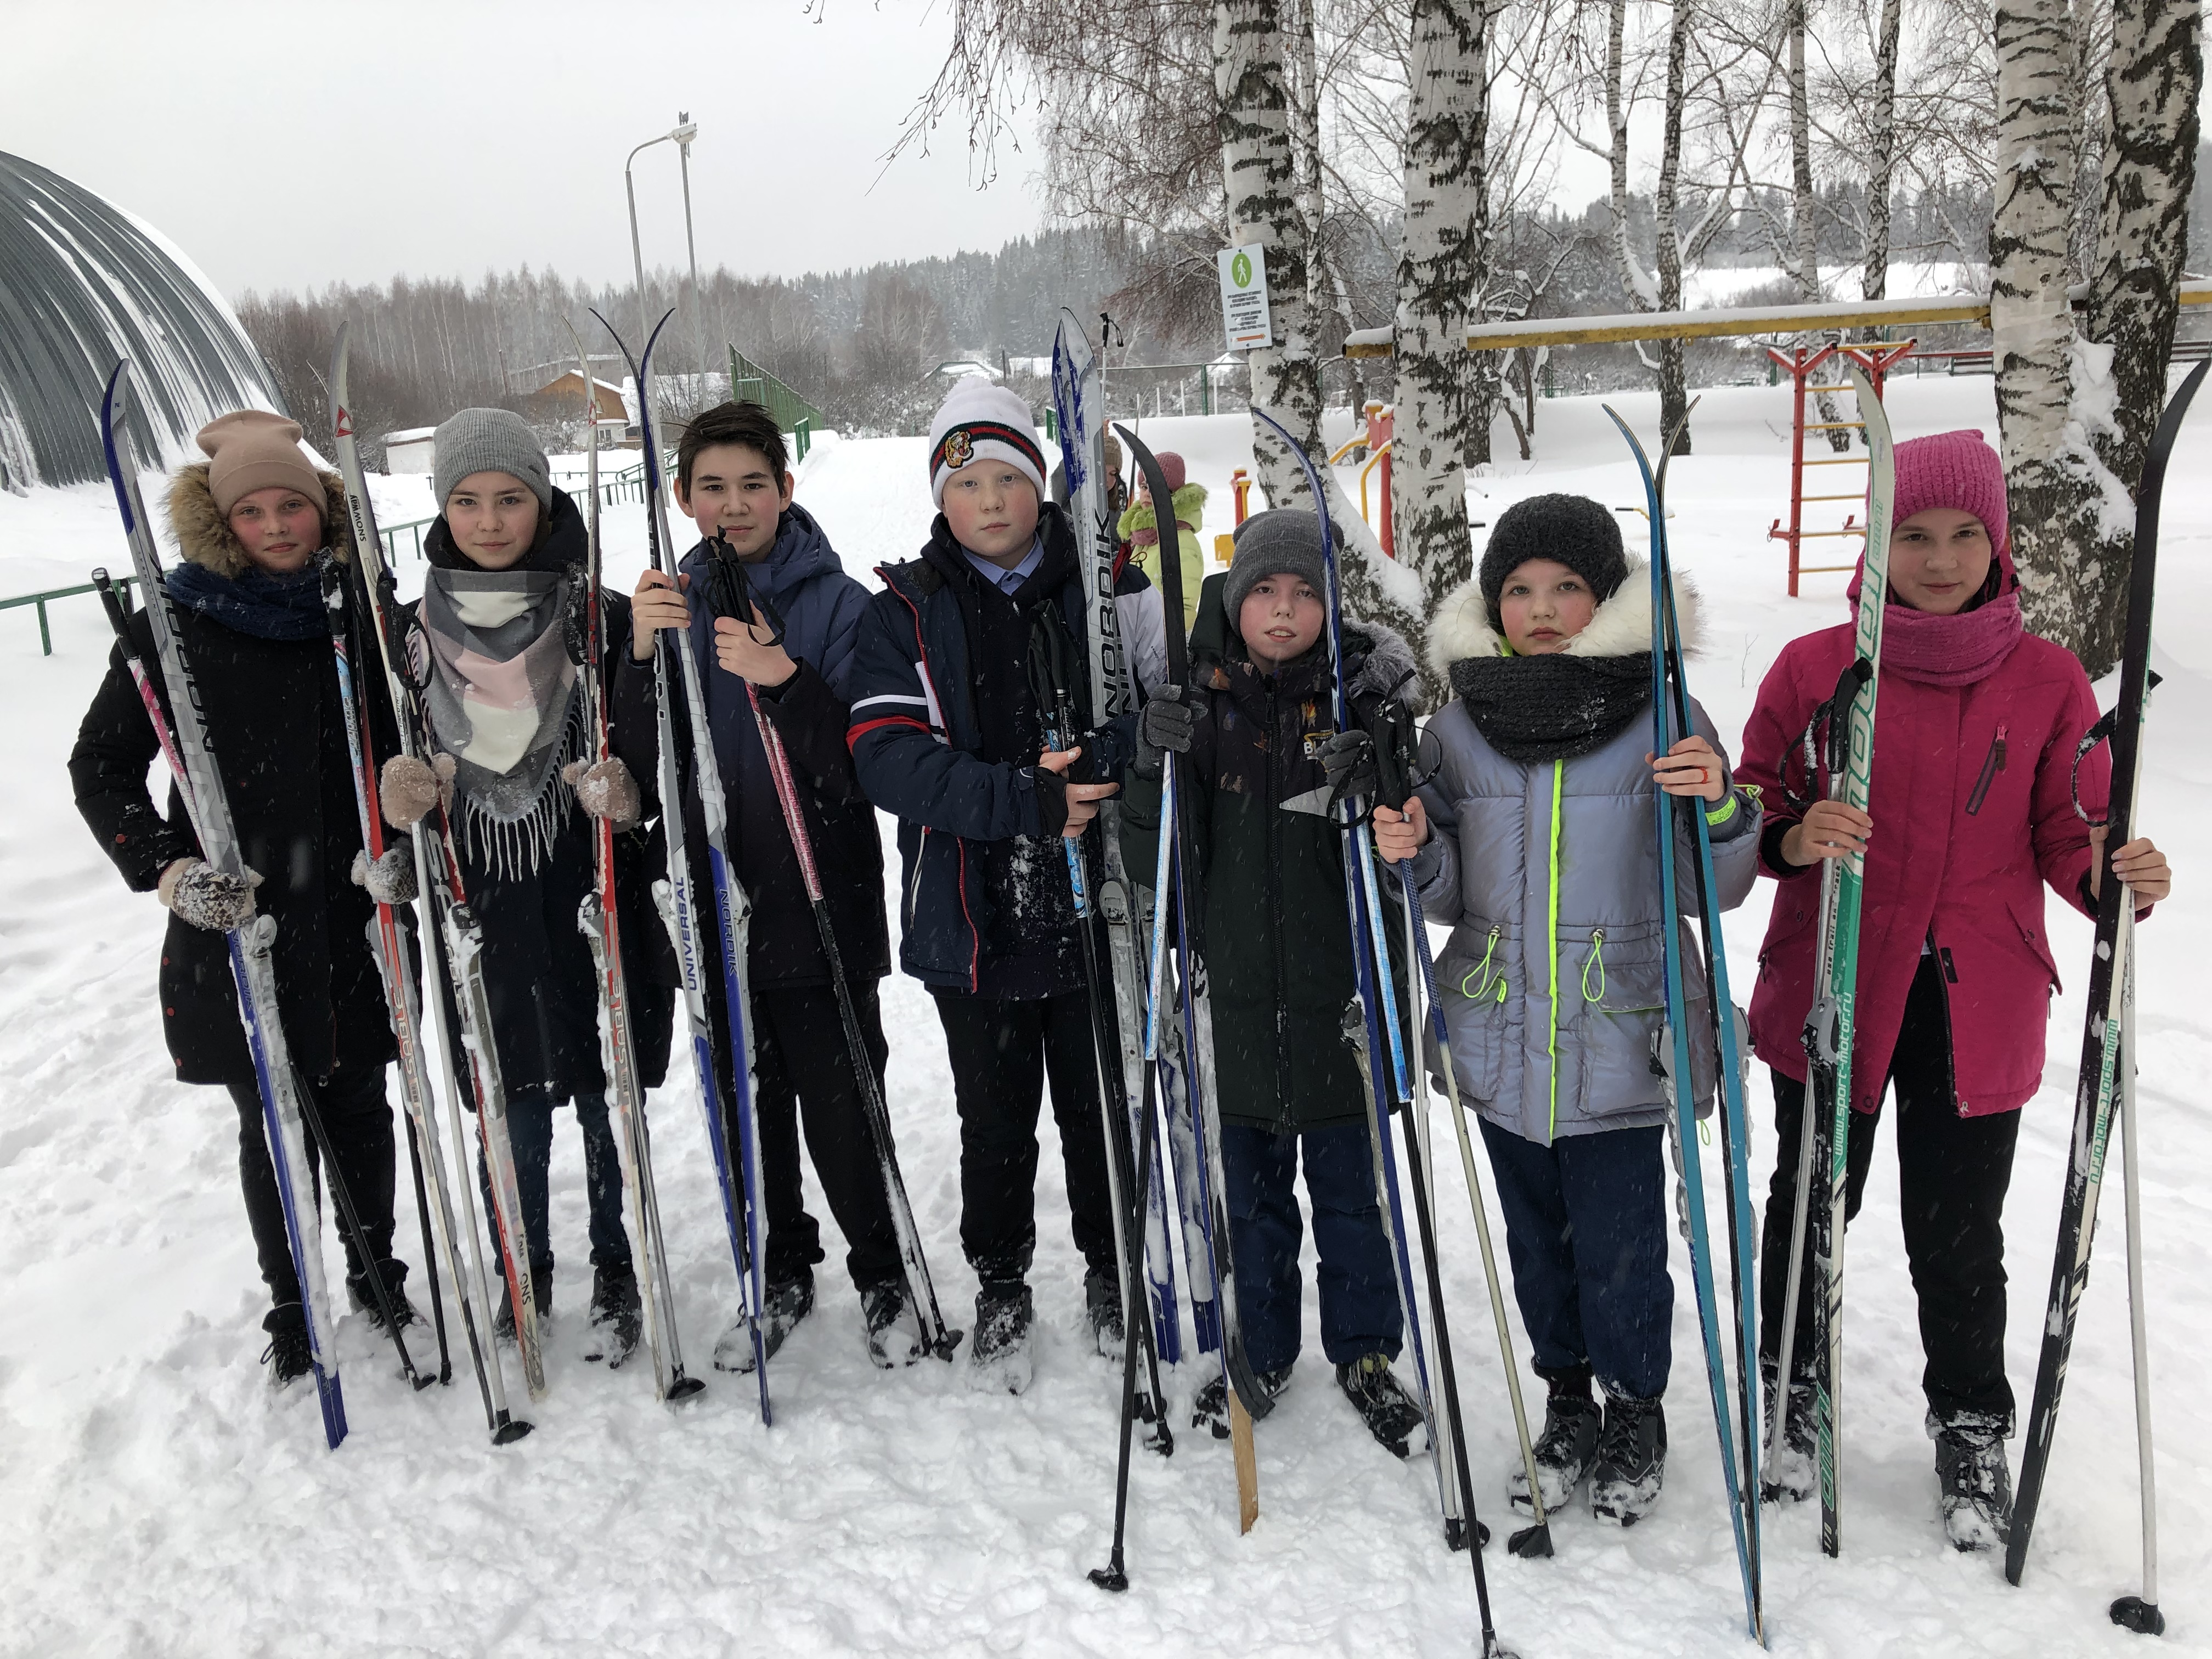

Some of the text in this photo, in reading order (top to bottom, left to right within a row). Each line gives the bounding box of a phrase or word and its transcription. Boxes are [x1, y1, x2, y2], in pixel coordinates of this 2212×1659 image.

[1094, 509, 1119, 720] NORDIK
[232, 929, 254, 1011] NORDIK
[676, 877, 697, 991] UNIVERSAL
[720, 889, 737, 977] NORDIK
[393, 987, 416, 1079] SABLE
[612, 976, 628, 1067] SABLE
[1835, 991, 1853, 1156] www.sport-motor.ru
[2090, 1018, 2119, 1184] www.sport-motor.ru
[1823, 1521, 1833, 1552] 170
